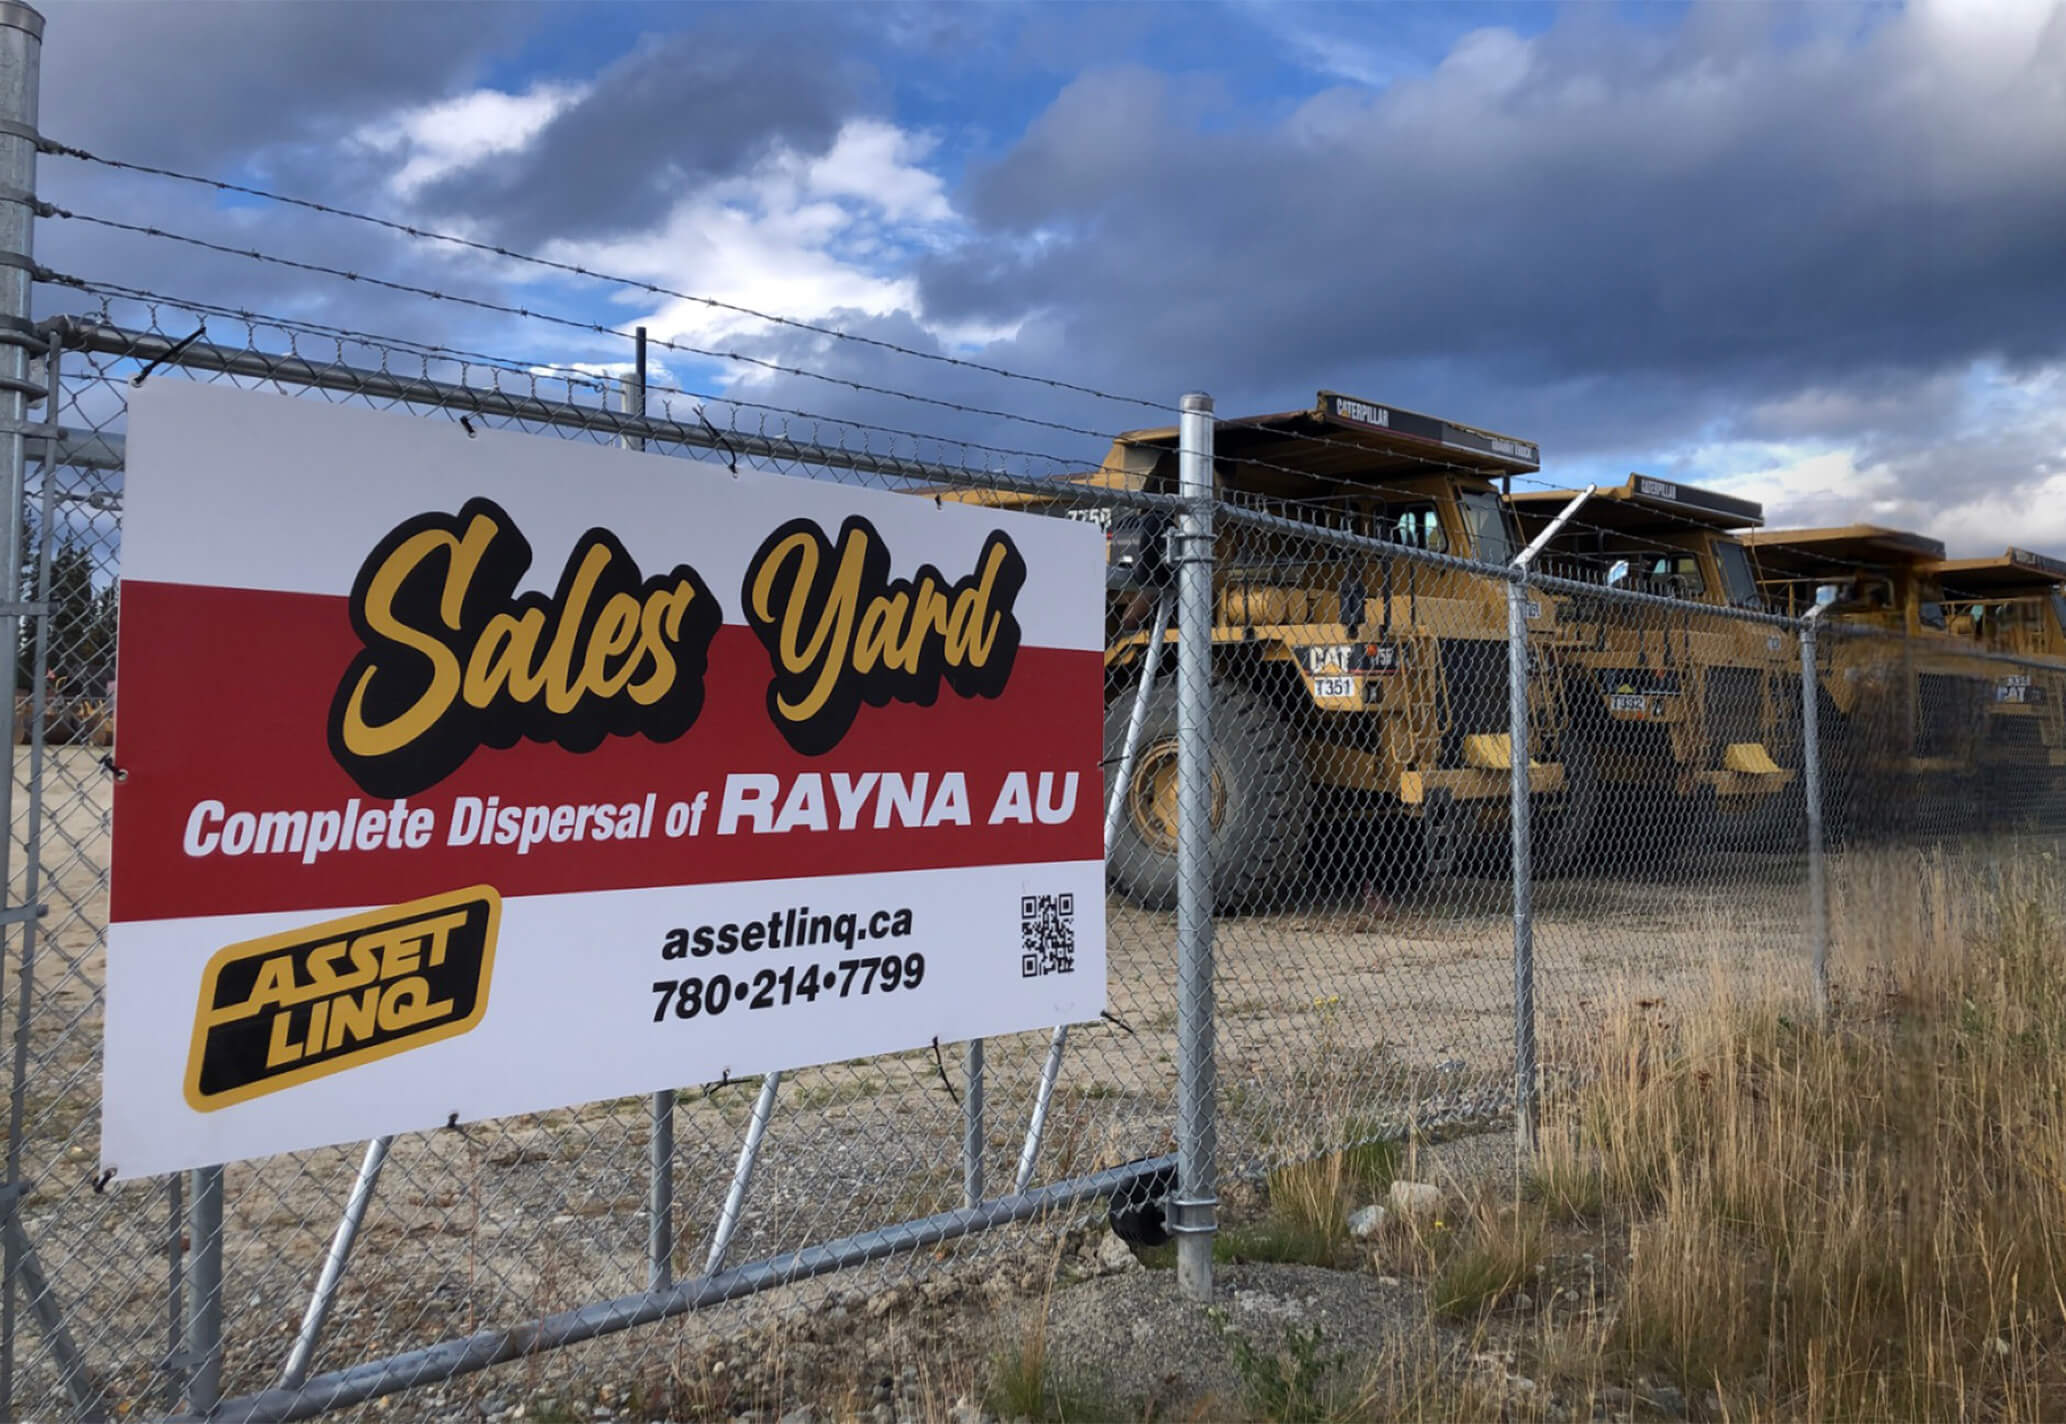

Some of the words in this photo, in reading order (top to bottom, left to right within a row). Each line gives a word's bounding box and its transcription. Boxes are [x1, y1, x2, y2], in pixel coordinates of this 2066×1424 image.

[1336, 398, 1390, 428] CATERPILLAR
[343, 513, 695, 757] Sales
[752, 528, 1007, 722] Yard
[1310, 646, 1352, 673] CAT
[1315, 679, 1351, 696] T351
[184, 798, 434, 864] Complete
[447, 793, 657, 854] Dispersal
[664, 791, 709, 837] of
[717, 771, 971, 836] RAYNA
[987, 771, 1080, 825] AU
[233, 910, 468, 1012] ASSET
[661, 906, 913, 960] assetlinq.ca
[265, 975, 454, 1068] LINQ
